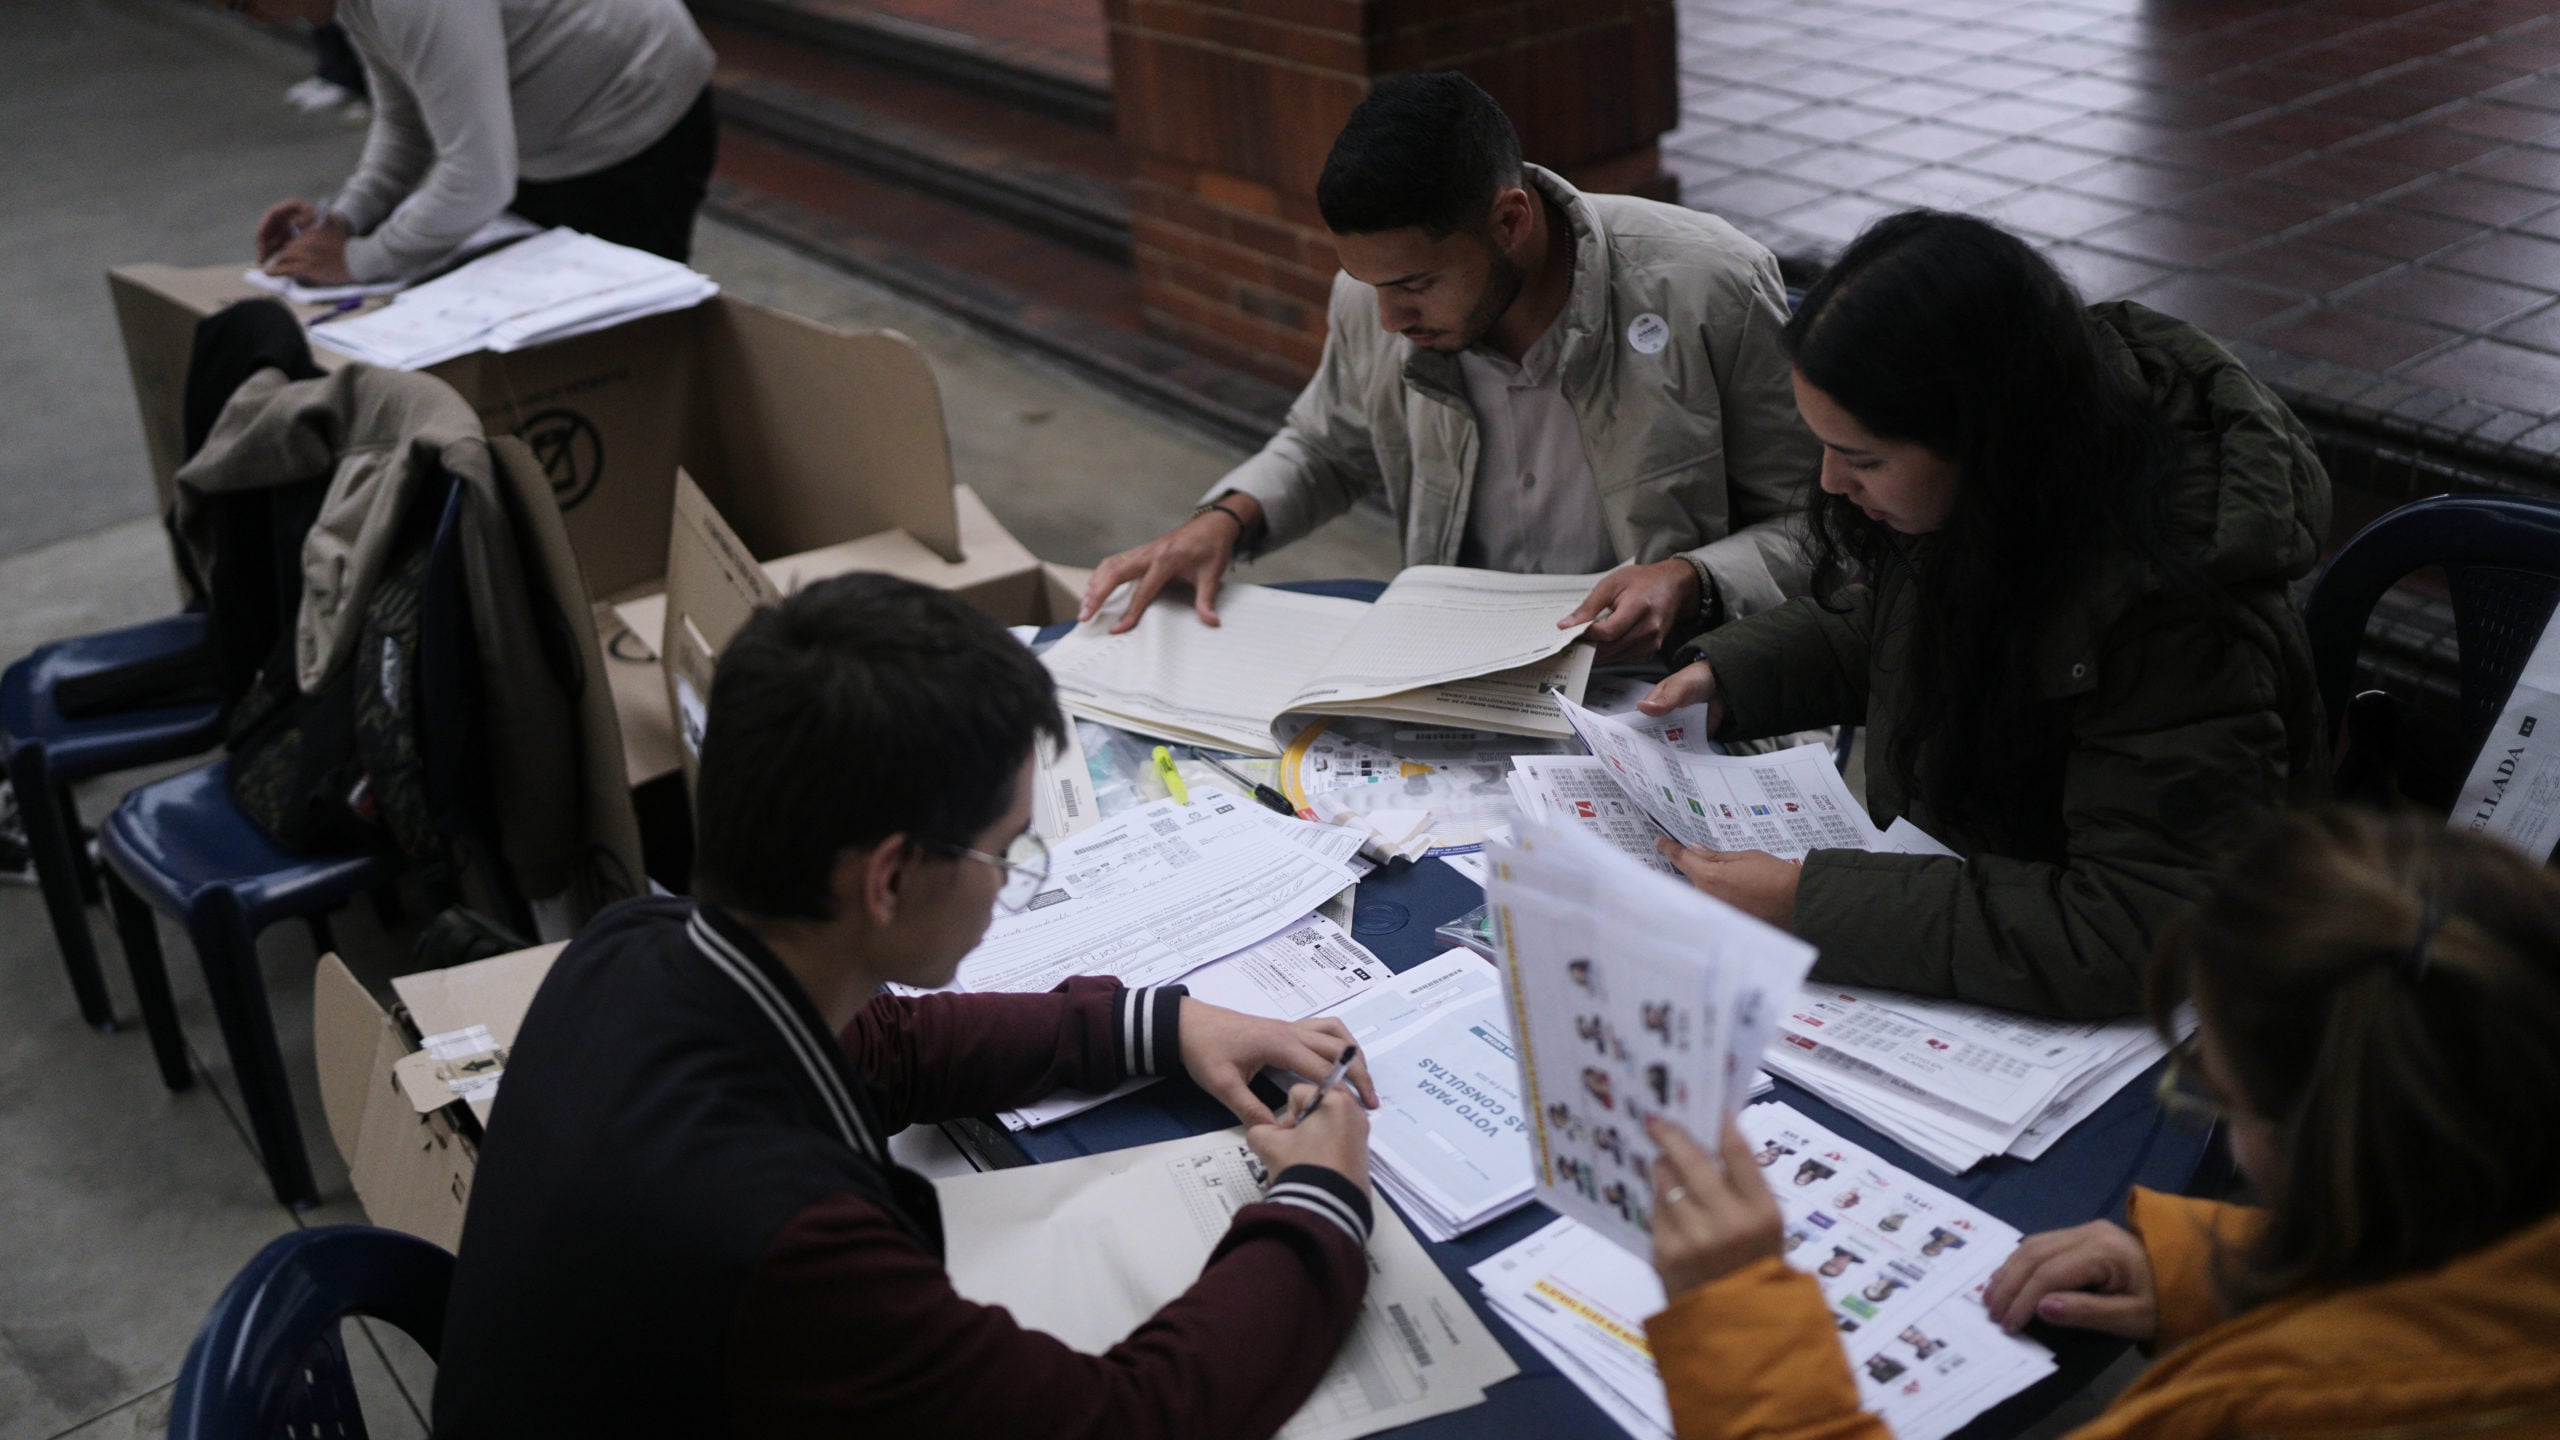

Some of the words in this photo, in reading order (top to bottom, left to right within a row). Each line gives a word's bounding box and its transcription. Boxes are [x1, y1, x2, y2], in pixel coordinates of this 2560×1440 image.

[1417, 1079, 1459, 1106] PARA
[1418, 1058, 1505, 1115] CONSULTAS
[1456, 1104, 1499, 1138] VOTO
